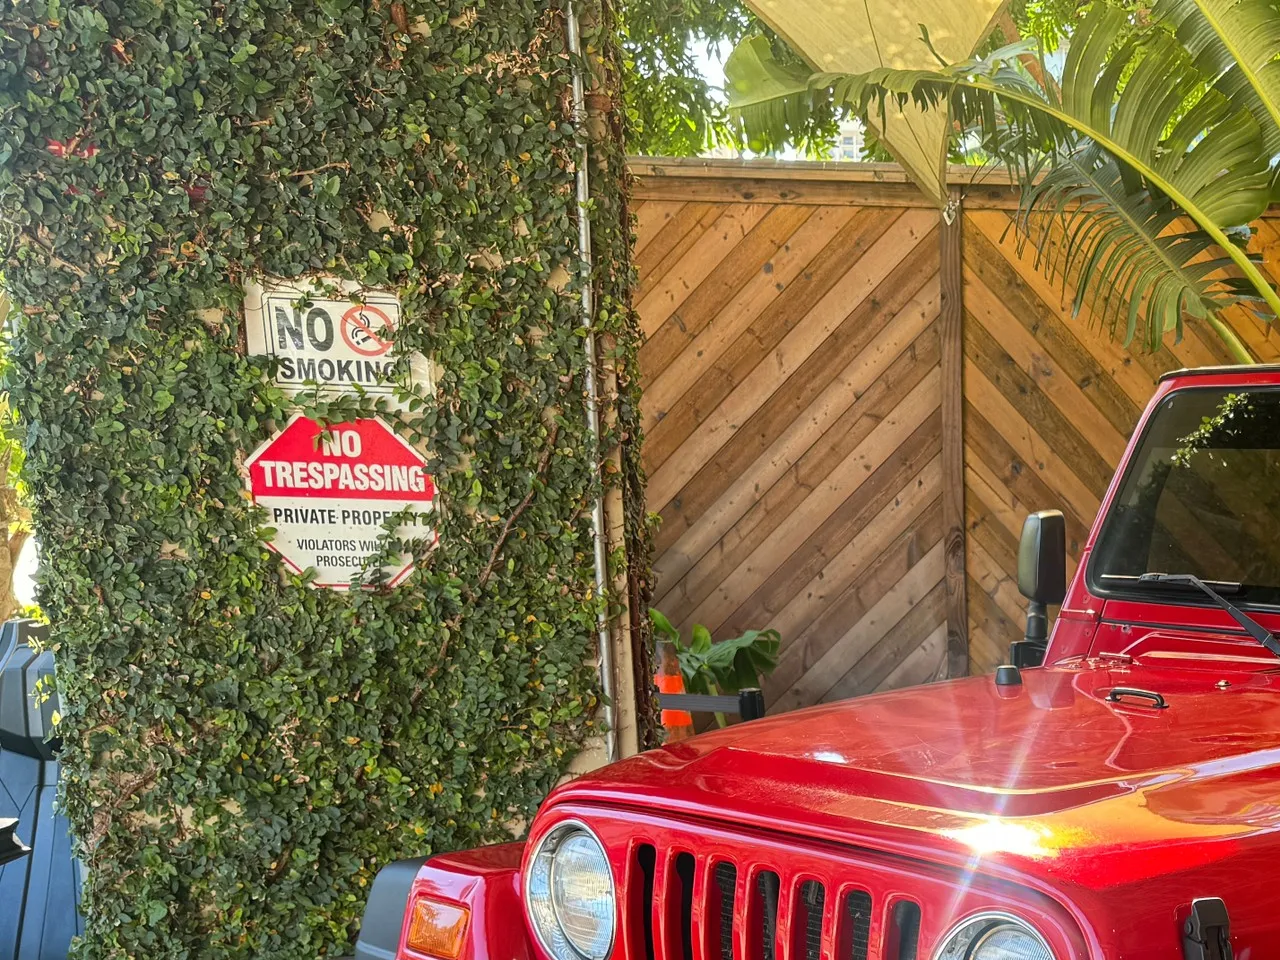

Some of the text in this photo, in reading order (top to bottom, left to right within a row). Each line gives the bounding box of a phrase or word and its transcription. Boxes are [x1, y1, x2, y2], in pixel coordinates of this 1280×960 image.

[275, 305, 334, 351] NO
[280, 358, 397, 384] SMOKING
[322, 429, 362, 458] NO
[259, 460, 426, 493] TRESPASSING
[273, 508, 336, 525] PRIVATE
[297, 538, 356, 552] VIOLATORS
